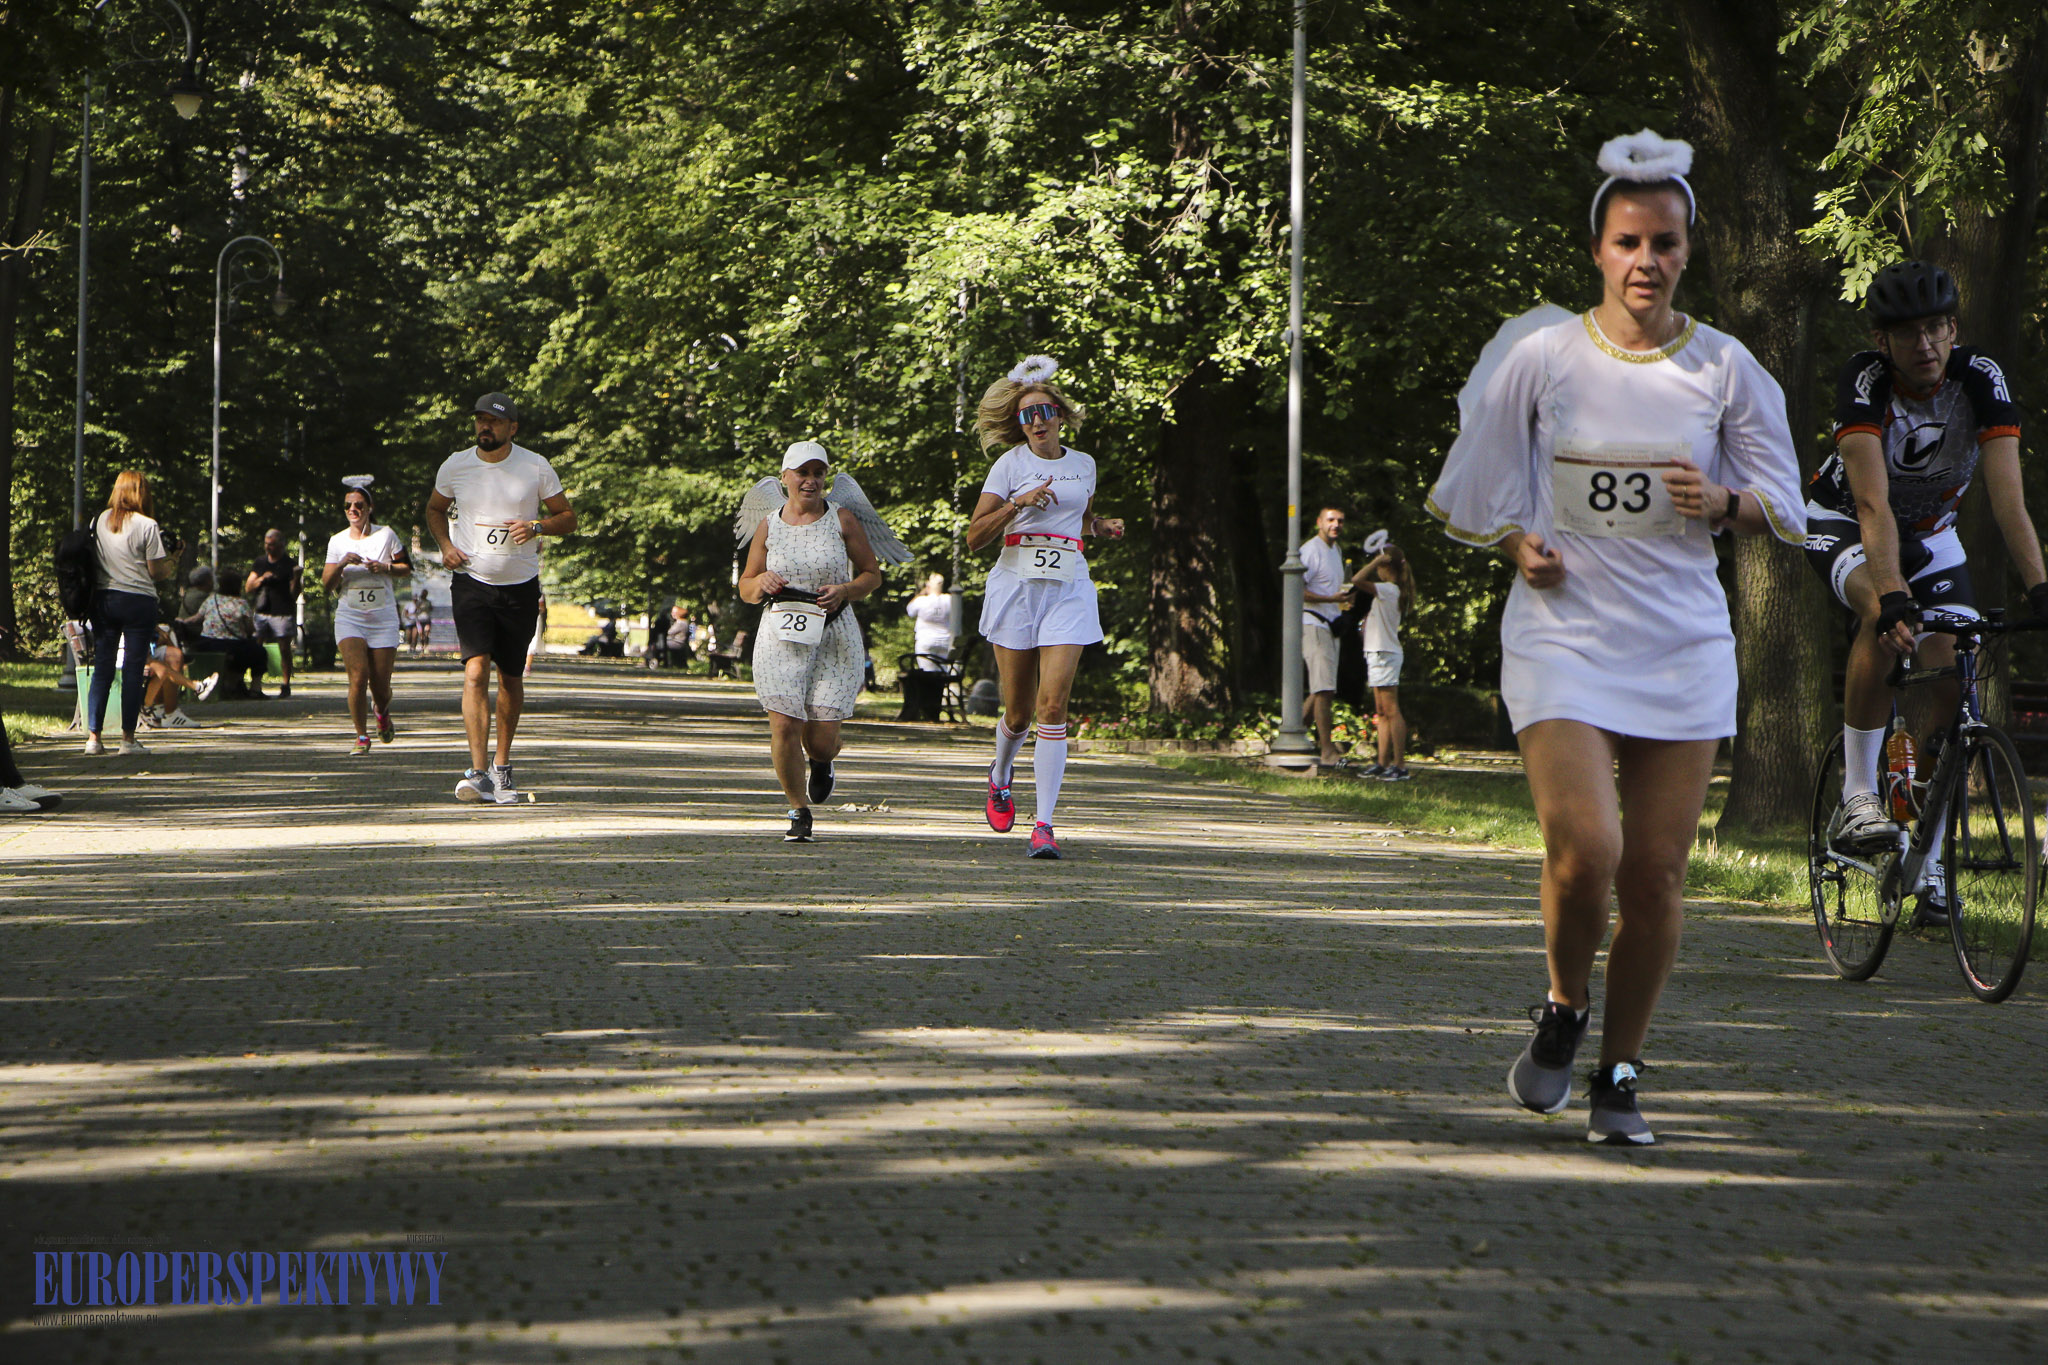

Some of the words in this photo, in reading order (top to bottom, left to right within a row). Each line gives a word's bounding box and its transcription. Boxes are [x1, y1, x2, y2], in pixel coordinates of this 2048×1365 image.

[1588, 471, 1651, 514] 83
[487, 529, 510, 545] 67
[1804, 534, 1840, 552] ERGE
[1034, 549, 1062, 569] 52
[358, 590, 376, 603] 16
[780, 613, 808, 632] 28
